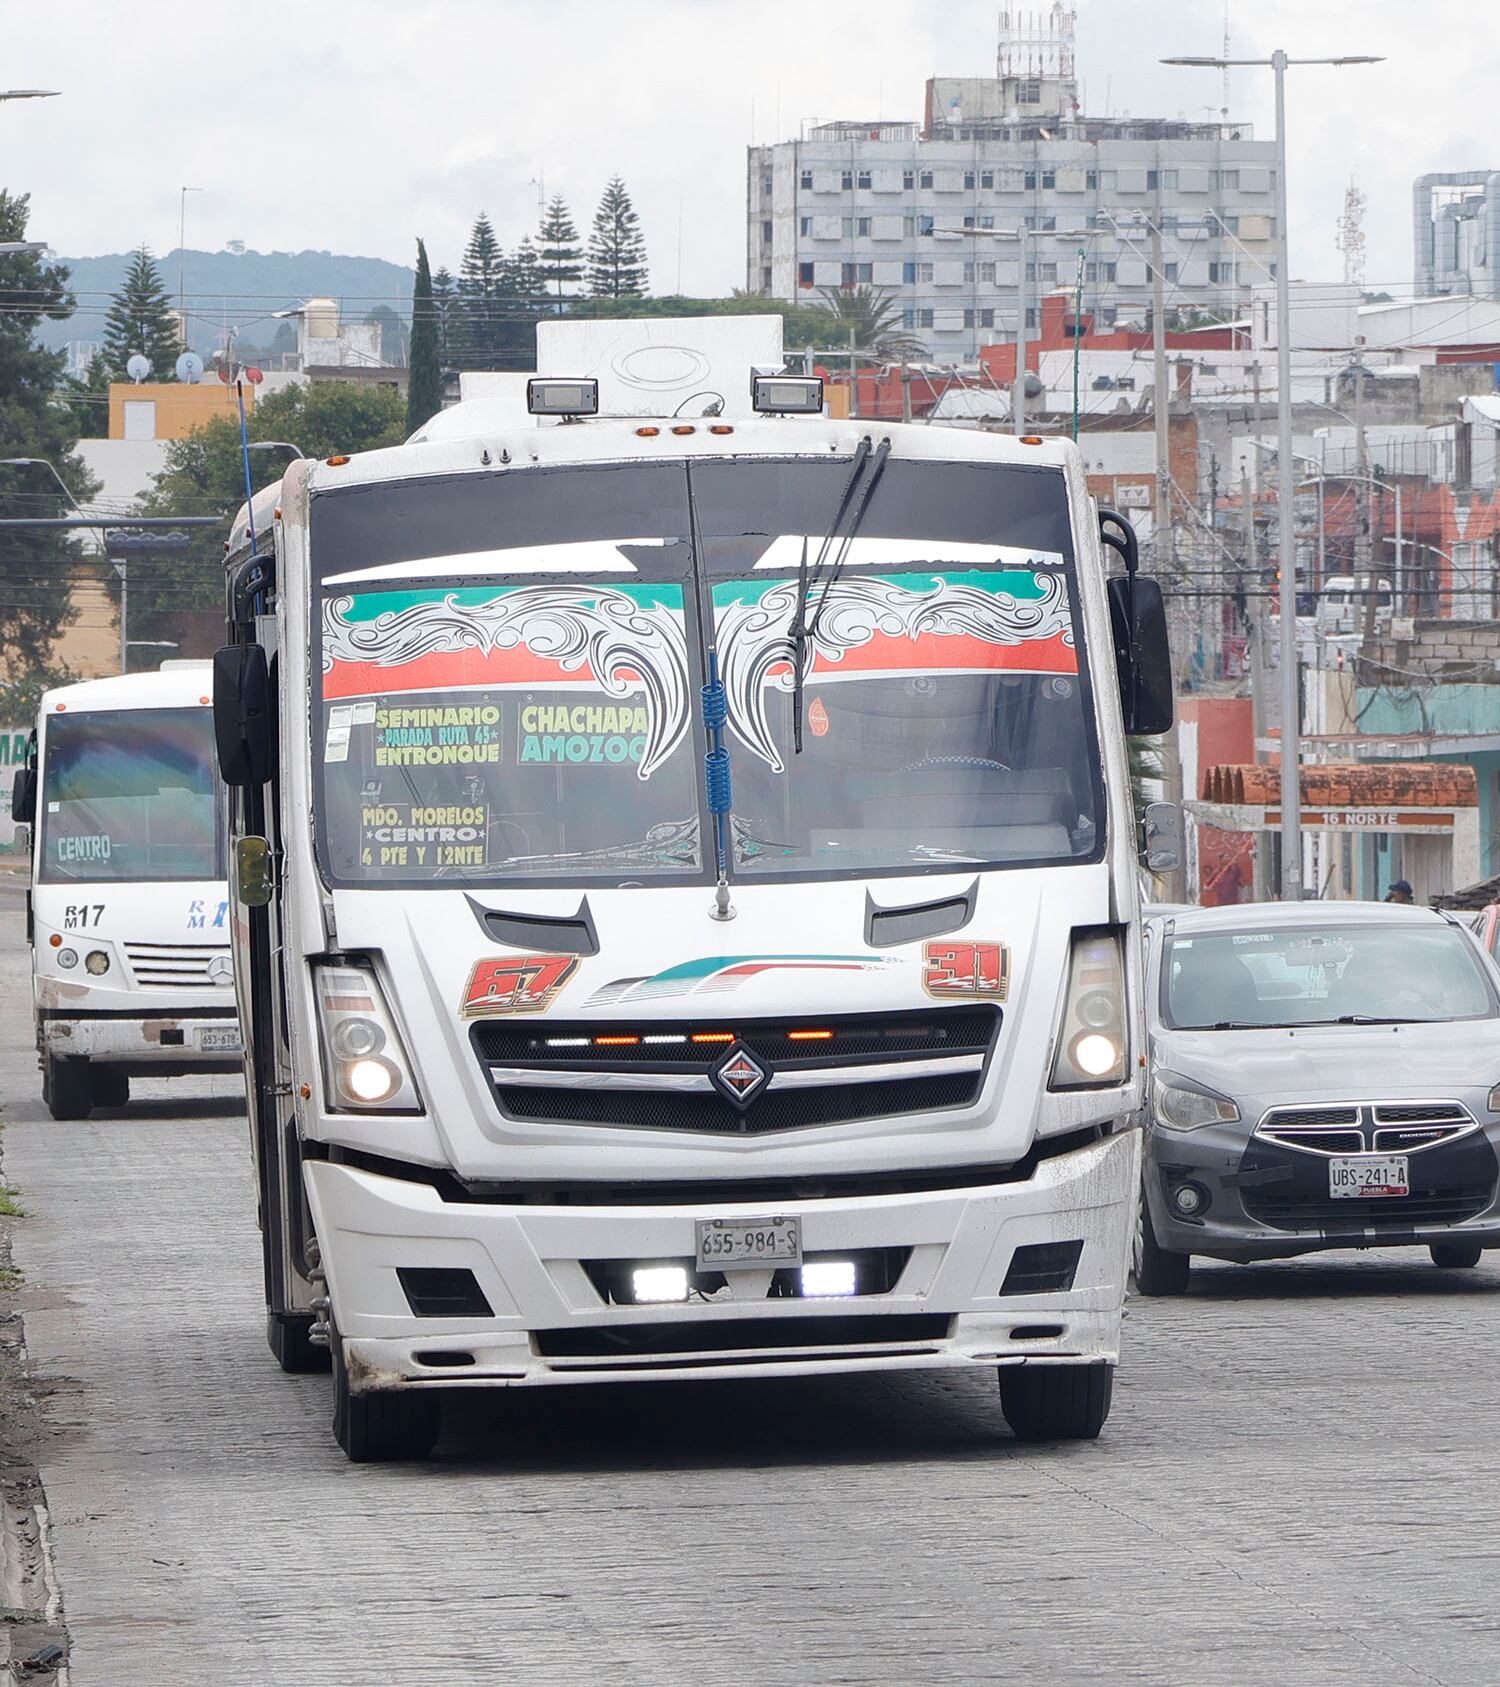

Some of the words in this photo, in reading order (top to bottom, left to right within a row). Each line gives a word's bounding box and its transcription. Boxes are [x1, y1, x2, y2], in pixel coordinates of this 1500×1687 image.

[376, 706, 500, 728] SEMINARIO
[521, 705, 648, 733] CHACHAPA
[385, 727, 433, 746] PARADA
[438, 726, 468, 745] RUTA
[375, 743, 499, 766] ENTRONQUE
[362, 807, 403, 827] MDO.
[410, 806, 484, 826] MORELOS
[1321, 813, 1339, 825] 16
[1345, 813, 1398, 825] NORTE
[374, 827, 478, 843] CENTRO
[58, 835, 112, 861] CENTRO
[362, 847, 373, 866] 4
[380, 846, 408, 866] PTE
[416, 847, 426, 865] Y
[65, 906, 77, 916] R
[78, 905, 105, 927] 17
[64, 918, 77, 928] M
[924, 943, 1007, 999] 31
[462, 956, 578, 1012] 67
[1332, 1168, 1406, 1186] UBS-241-A
